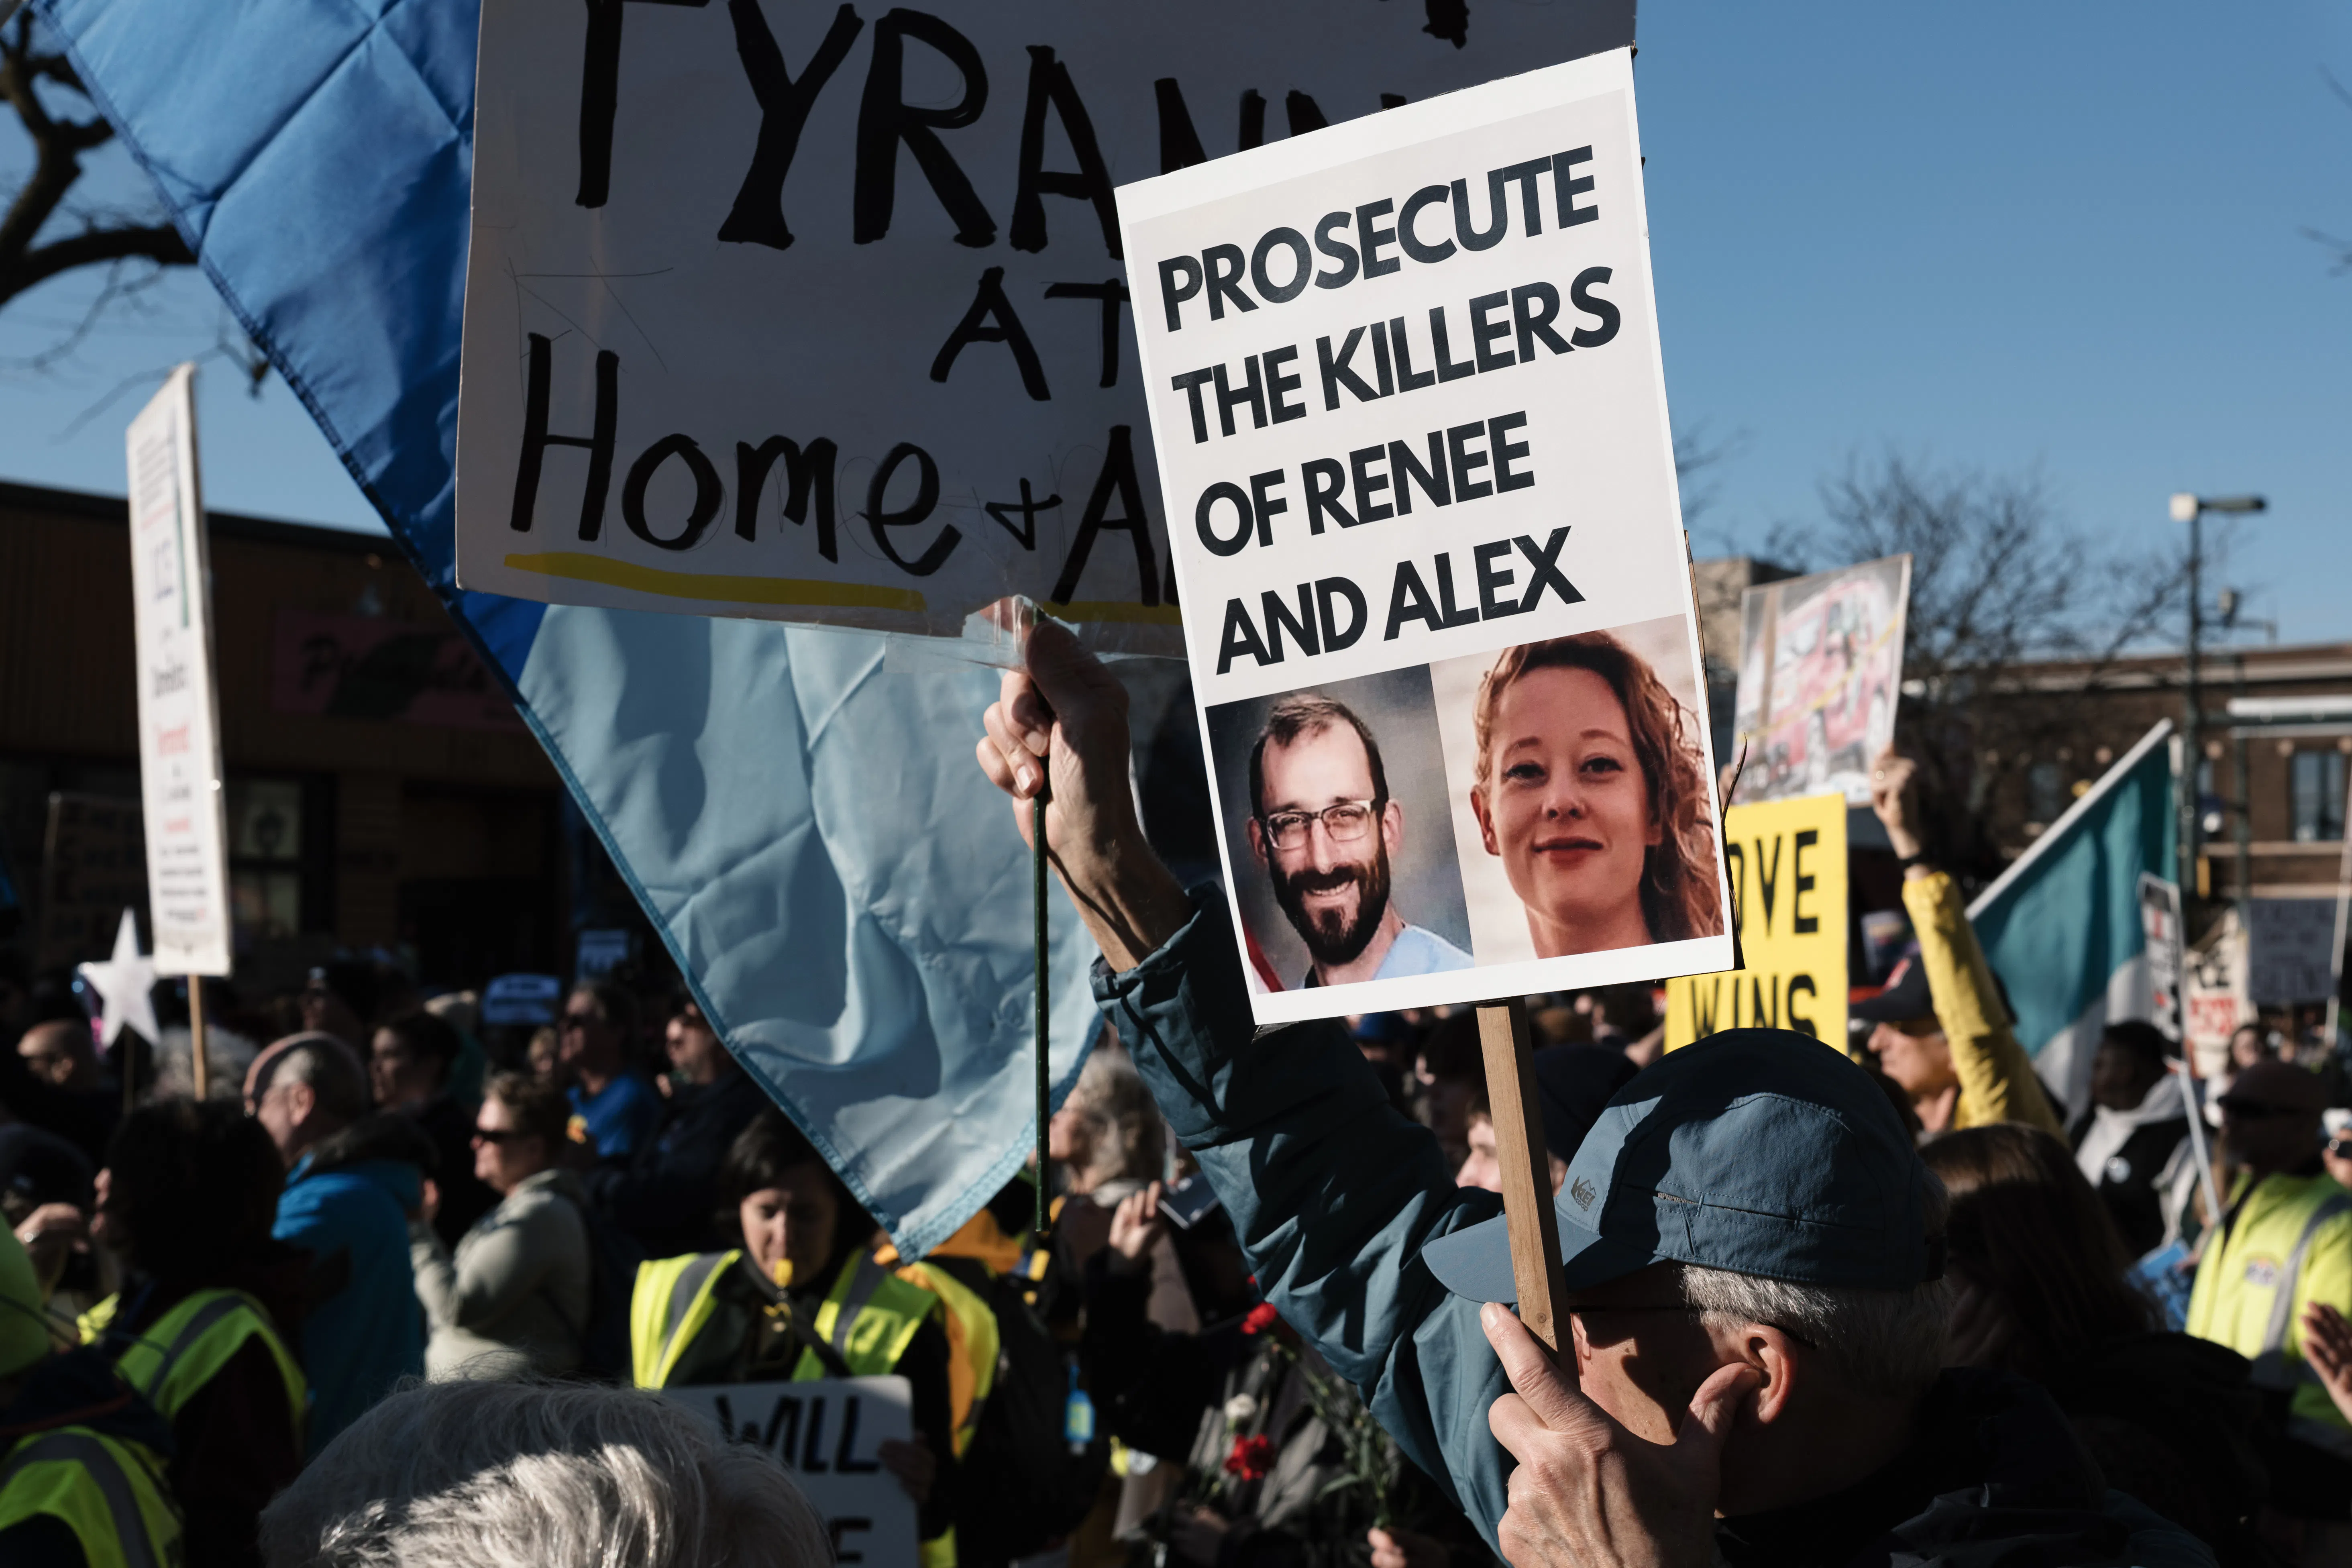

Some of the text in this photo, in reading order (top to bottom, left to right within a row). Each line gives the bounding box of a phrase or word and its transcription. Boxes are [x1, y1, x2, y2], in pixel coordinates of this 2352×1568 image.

[1158, 145, 1599, 332] PROSECUTE
[930, 266, 1130, 401] AT
[1172, 267, 1620, 444] THE KILLERS
[510, 332, 962, 577] Home
[1195, 410, 1535, 557] OF RENEE
[1216, 526, 1586, 675] AND ALEX
